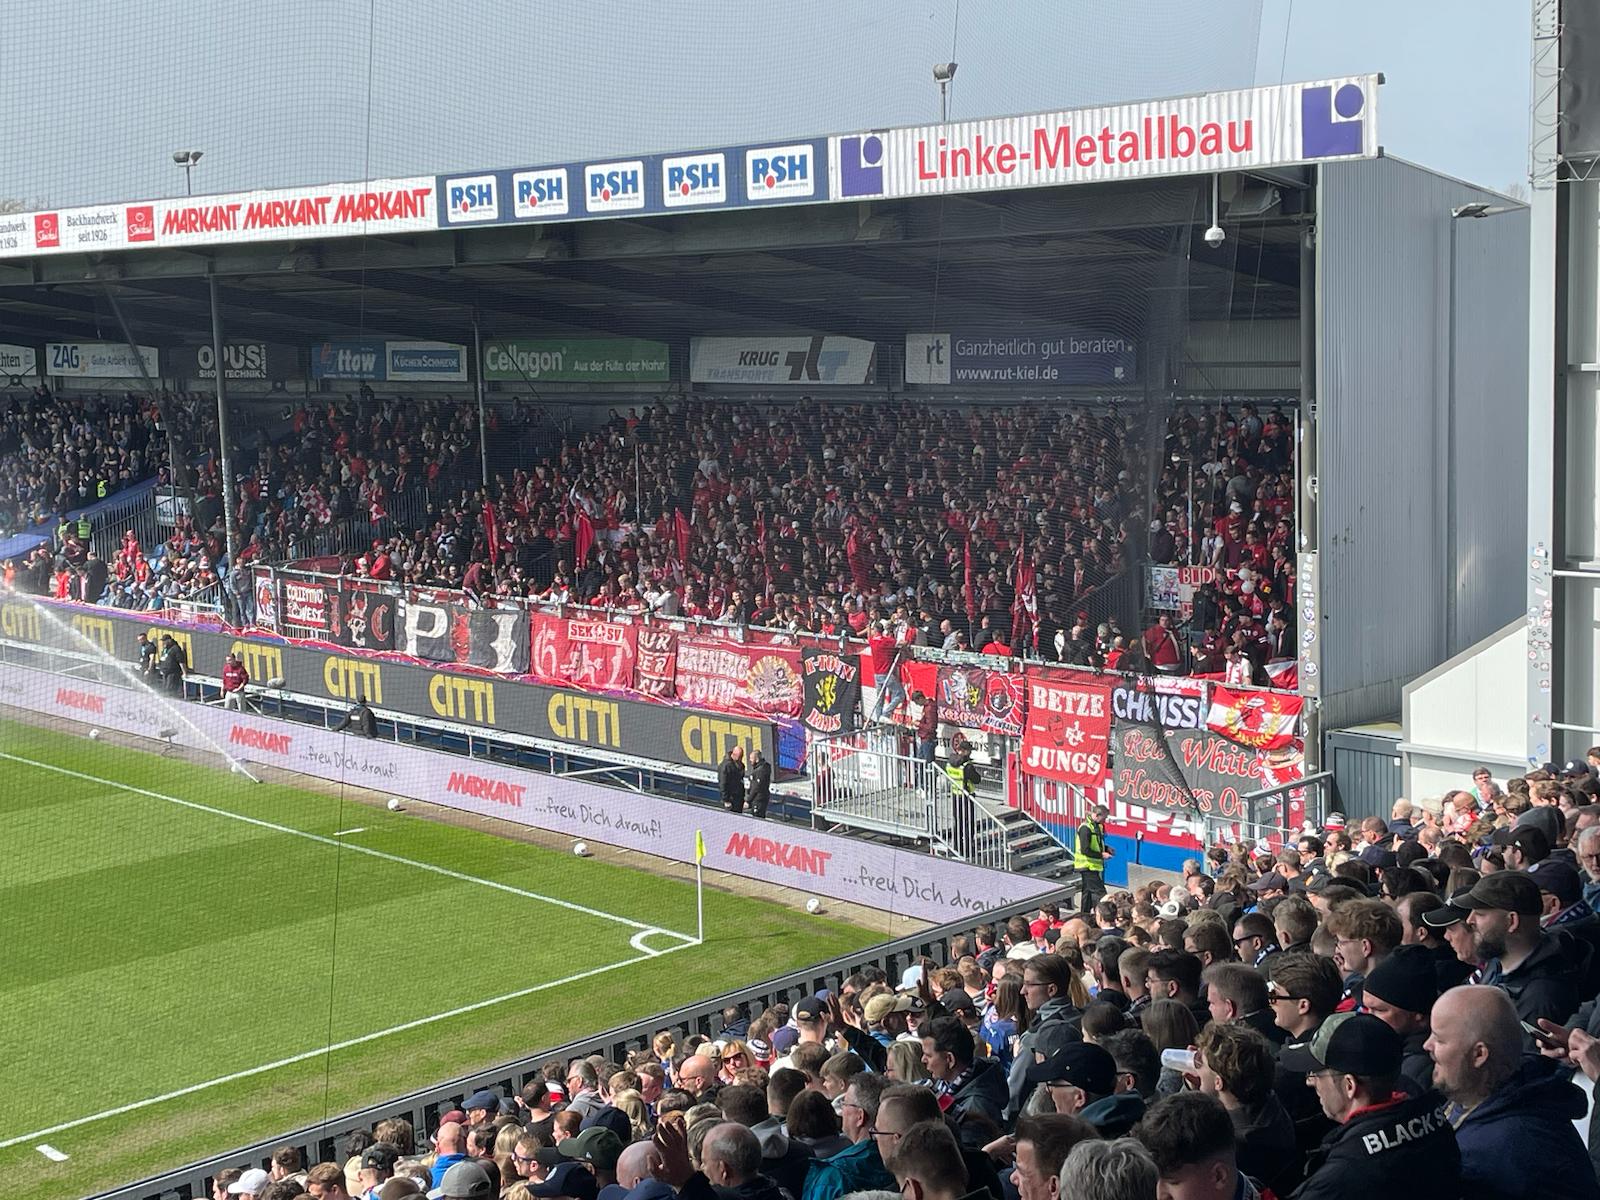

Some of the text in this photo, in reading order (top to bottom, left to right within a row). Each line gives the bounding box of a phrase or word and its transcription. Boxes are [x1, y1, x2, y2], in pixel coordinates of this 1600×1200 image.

[918, 114, 1253, 181] Linke-Metallbau
[591, 170, 639, 197] RSH
[668, 163, 721, 191] RSH
[752, 154, 808, 184] RSH
[451, 183, 493, 209] RSH
[518, 177, 563, 203] RSH
[66, 212, 118, 227] Backhandwerk
[162, 204, 242, 235] MARKANT
[243, 197, 332, 229] MARKANT
[333, 188, 432, 224] MARKANT
[78, 229, 108, 242] seit 1926
[53, 345, 80, 369] ZAG
[738, 351, 780, 366] KRUG
[926, 339, 944, 365] rt
[955, 339, 1036, 356] Ganzheitlich
[1041, 340, 1065, 360] gut
[199, 369, 261, 379] SHOTECHNIK
[574, 360, 588, 371] Aus
[590, 360, 604, 371] der
[625, 360, 640, 371] der
[642, 359, 666, 371] Natur
[956, 365, 1059, 380] www.rut-kiel.de
[570, 624, 622, 641] SEK SV
[324, 656, 383, 704] CITTI
[429, 673, 496, 725] CITTI
[1033, 685, 1105, 718] BETZE
[547, 692, 621, 748] CITTI
[229, 724, 293, 756] MARKANT
[336, 751, 358, 771] Dich
[681, 714, 763, 770] CITTI
[1027, 745, 1102, 776] JUNGS
[1180, 738, 1262, 780] White
[447, 771, 527, 808] MARKANT
[580, 803, 611, 826] Dich
[614, 815, 662, 839] drauf!
[725, 832, 832, 877] MARKANT
[903, 875, 944, 905] Dich
[1362, 1112, 1436, 1155] BLACK
